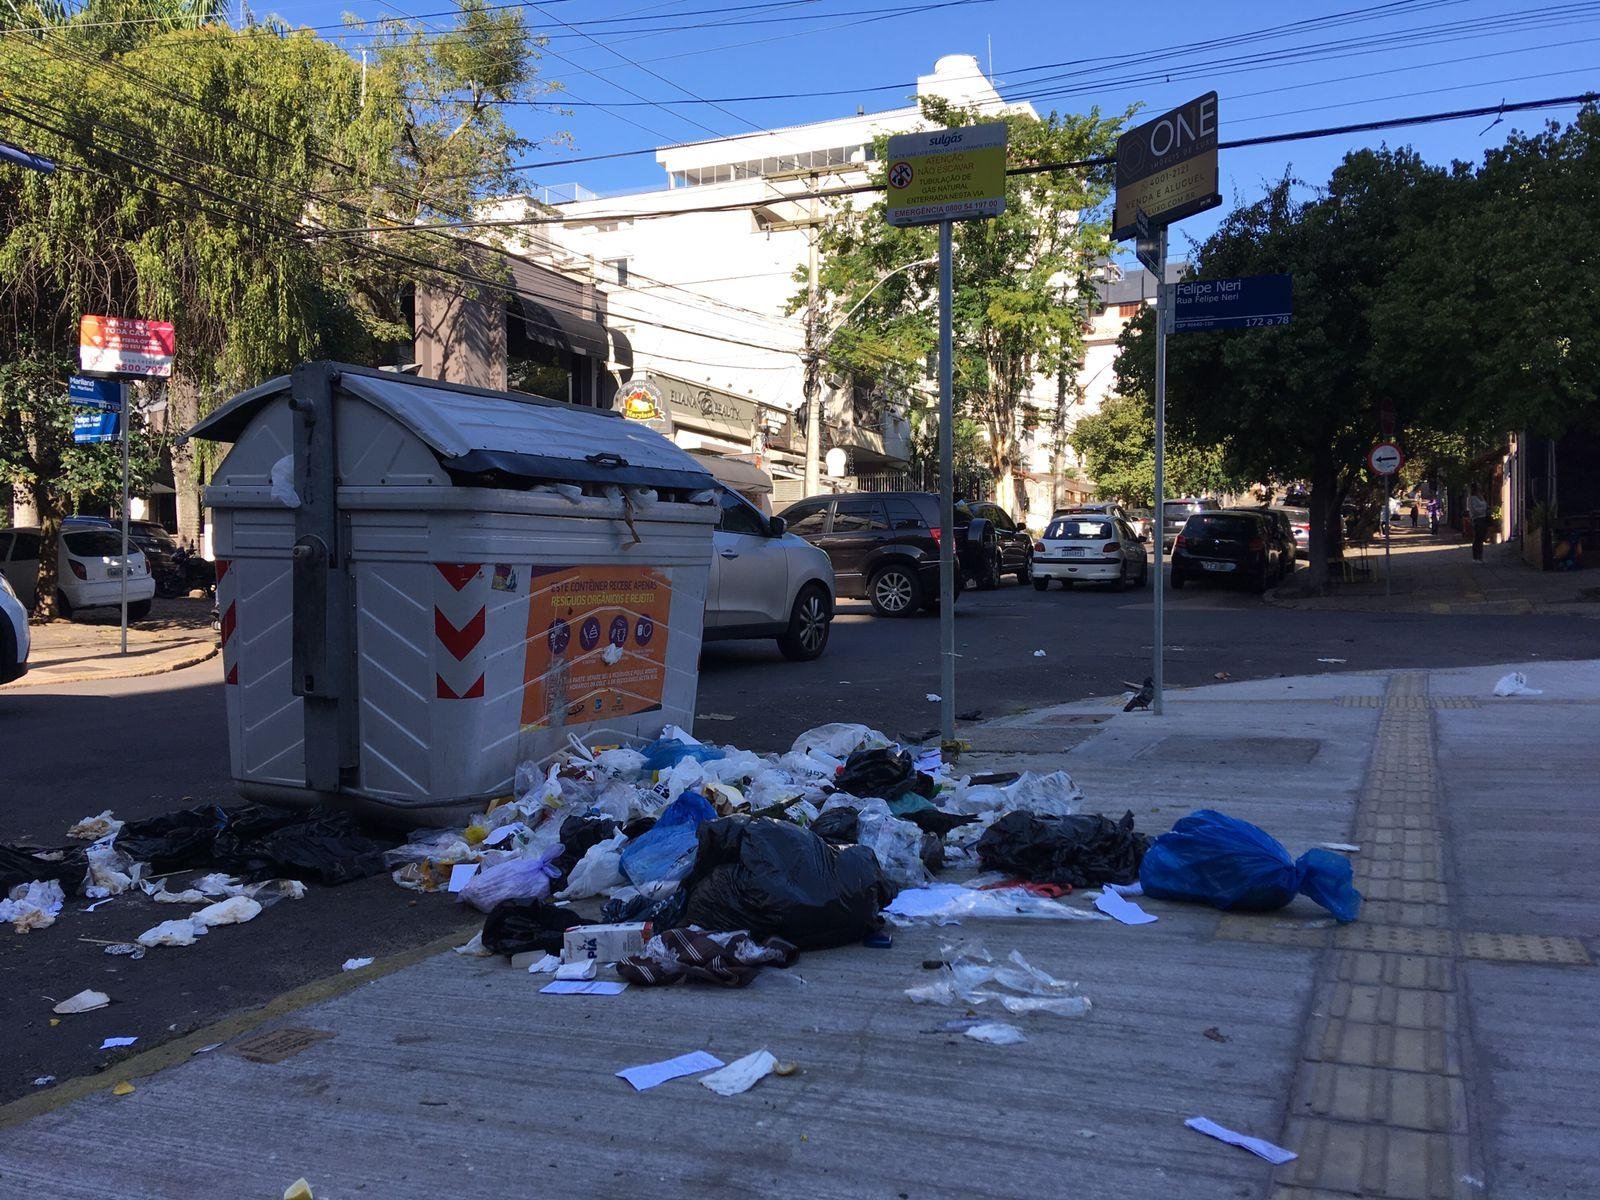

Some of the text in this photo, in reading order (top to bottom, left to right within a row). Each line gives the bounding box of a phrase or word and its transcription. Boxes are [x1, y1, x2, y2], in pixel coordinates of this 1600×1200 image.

[1150, 97, 1215, 157] ONE
[929, 131, 963, 147] sulgás
[926, 153, 965, 165] ATENÇÃO
[917, 162, 975, 176] NÃO ESCAVAR
[919, 173, 972, 186] TUBULAÇÃO DE
[1156, 190, 1162, 198] E
[1164, 174, 1205, 195] ALUGUEL
[921, 183, 969, 194] GÁS NATURAL
[906, 194, 949, 205] ENTERRADA
[949, 192, 972, 200] NESTA
[894, 205, 944, 217] EMERGÊNCIA
[945, 203, 963, 213] 0800
[975, 201, 987, 209] 197
[988, 200, 998, 208] 00
[1177, 280, 1241, 295] Felipe Neri
[1195, 295, 1219, 304] Felipe
[1221, 293, 1239, 301] Neri
[1246, 318, 1264, 327] 172
[1277, 316, 1289, 325] 78
[104, 327, 151, 337] TODA CASA
[626, 409, 656, 420] Maryland
[587, 592, 624, 606] ORGÂNICOS
